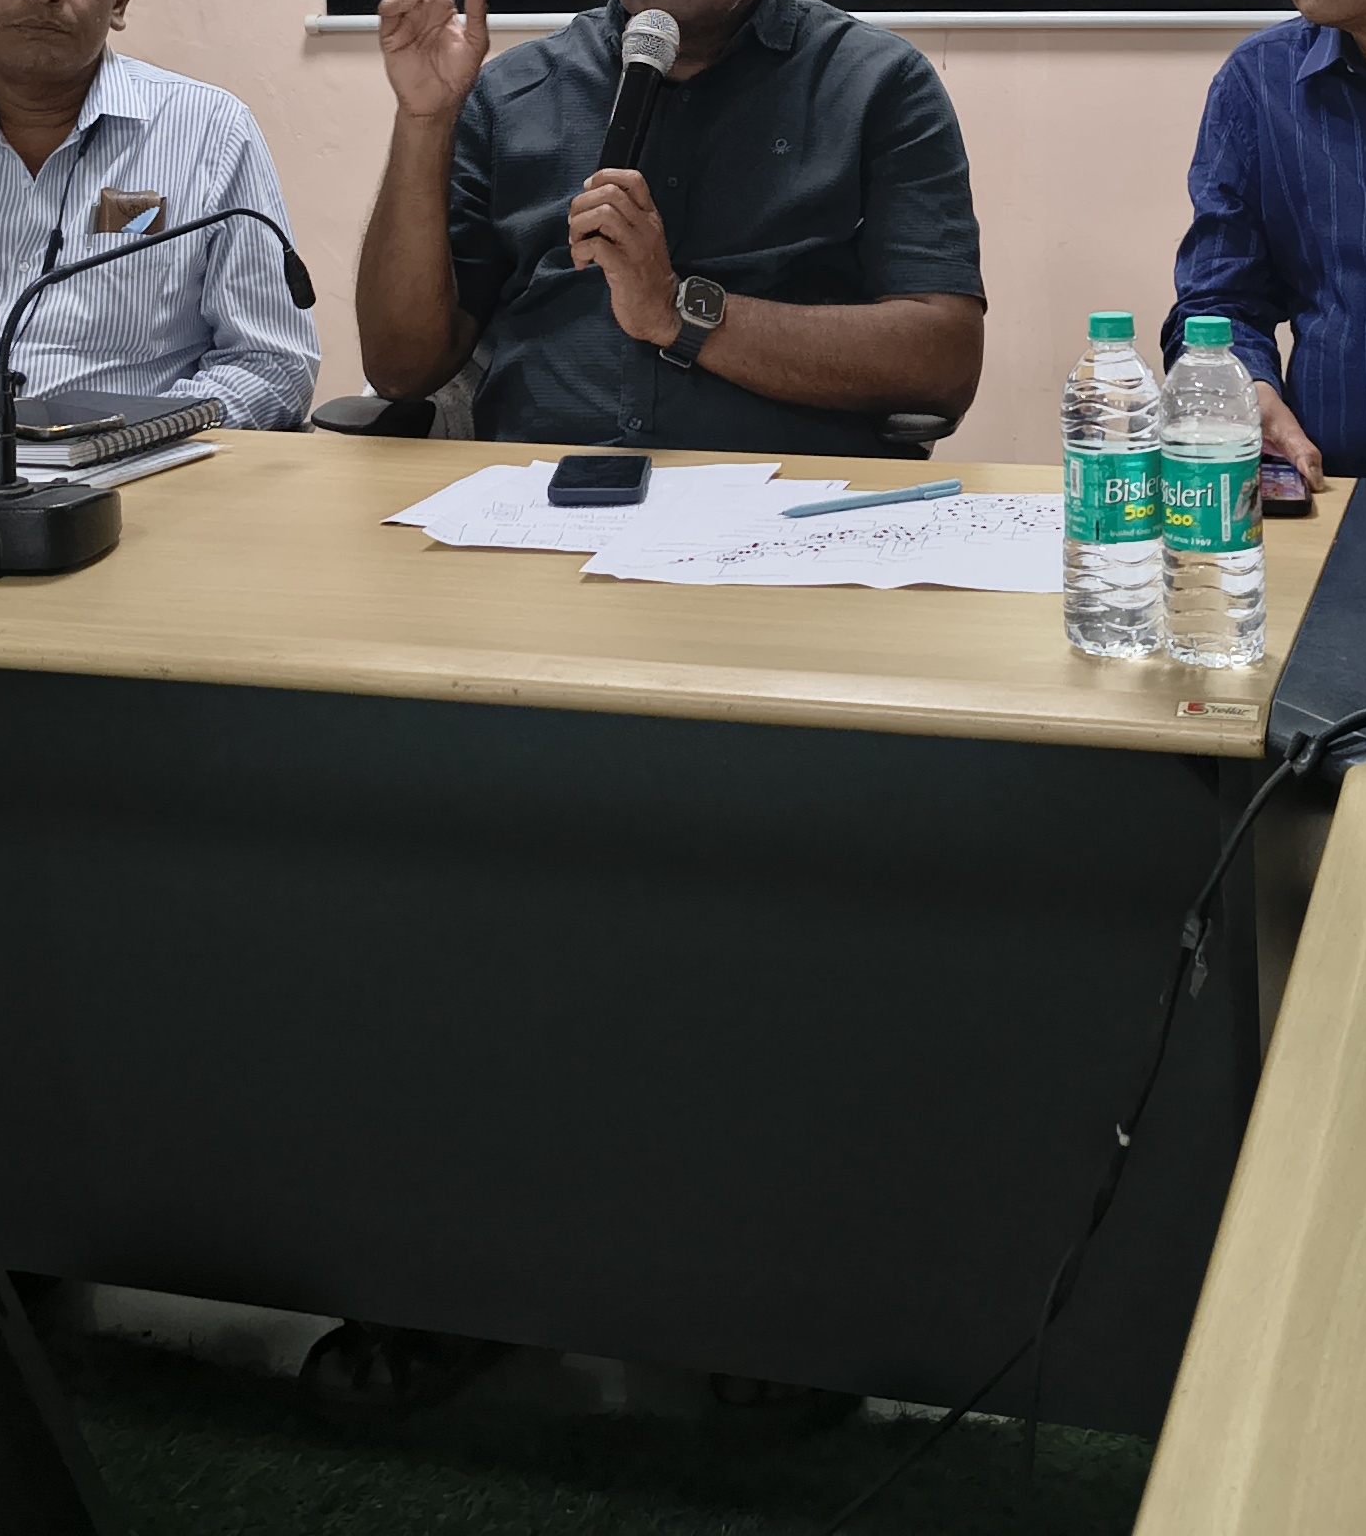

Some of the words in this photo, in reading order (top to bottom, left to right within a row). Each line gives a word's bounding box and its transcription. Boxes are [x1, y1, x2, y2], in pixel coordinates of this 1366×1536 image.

[1105, 472, 1161, 504] Bisler
[1124, 504, 1155, 521] 500
[1165, 508, 1193, 526] 500
